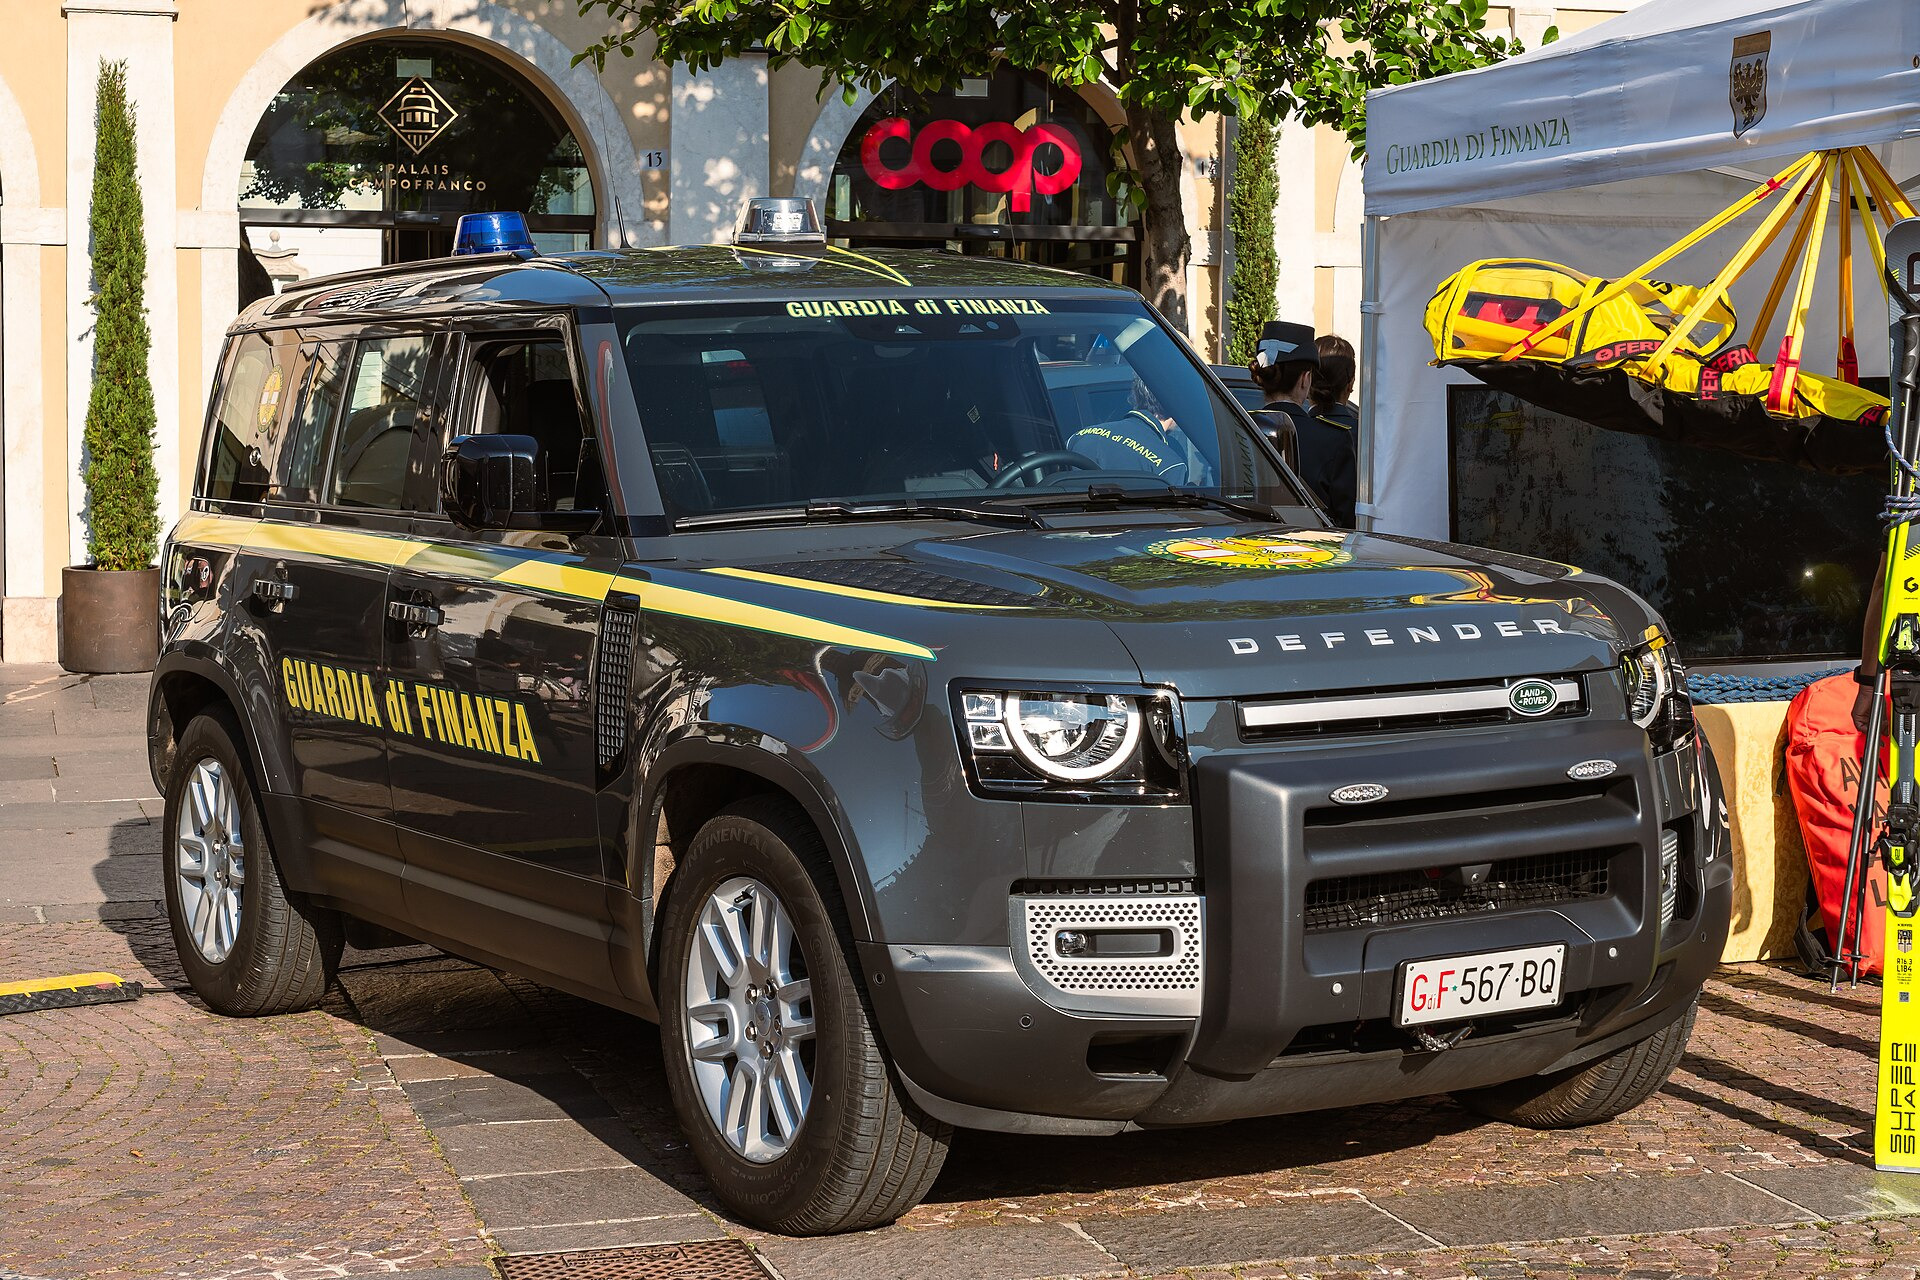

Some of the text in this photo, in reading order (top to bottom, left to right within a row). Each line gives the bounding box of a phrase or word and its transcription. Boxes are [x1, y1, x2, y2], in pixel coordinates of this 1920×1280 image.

[646, 152, 663, 168] 13
[1386, 117, 1571, 175] GUARDIA DI FINANZA
[387, 163, 449, 175] PALAIS
[860, 117, 1082, 213] coop
[348, 178, 487, 191] CAMPOFRANCO
[785, 299, 1051, 318] GUARDIA di FINANZA
[1111, 434, 1121, 443] di
[1122, 437, 1163, 467] FINANZA
[1227, 618, 1565, 655] DEFENDER
[1520, 688, 1540, 698] LAND
[1522, 695, 1548, 706] ROVER
[281, 656, 543, 766] GUARDIA di FINANZA
[1890, 1042, 1903, 1154] SUPER
[1903, 1043, 1917, 1155] SHAPE
